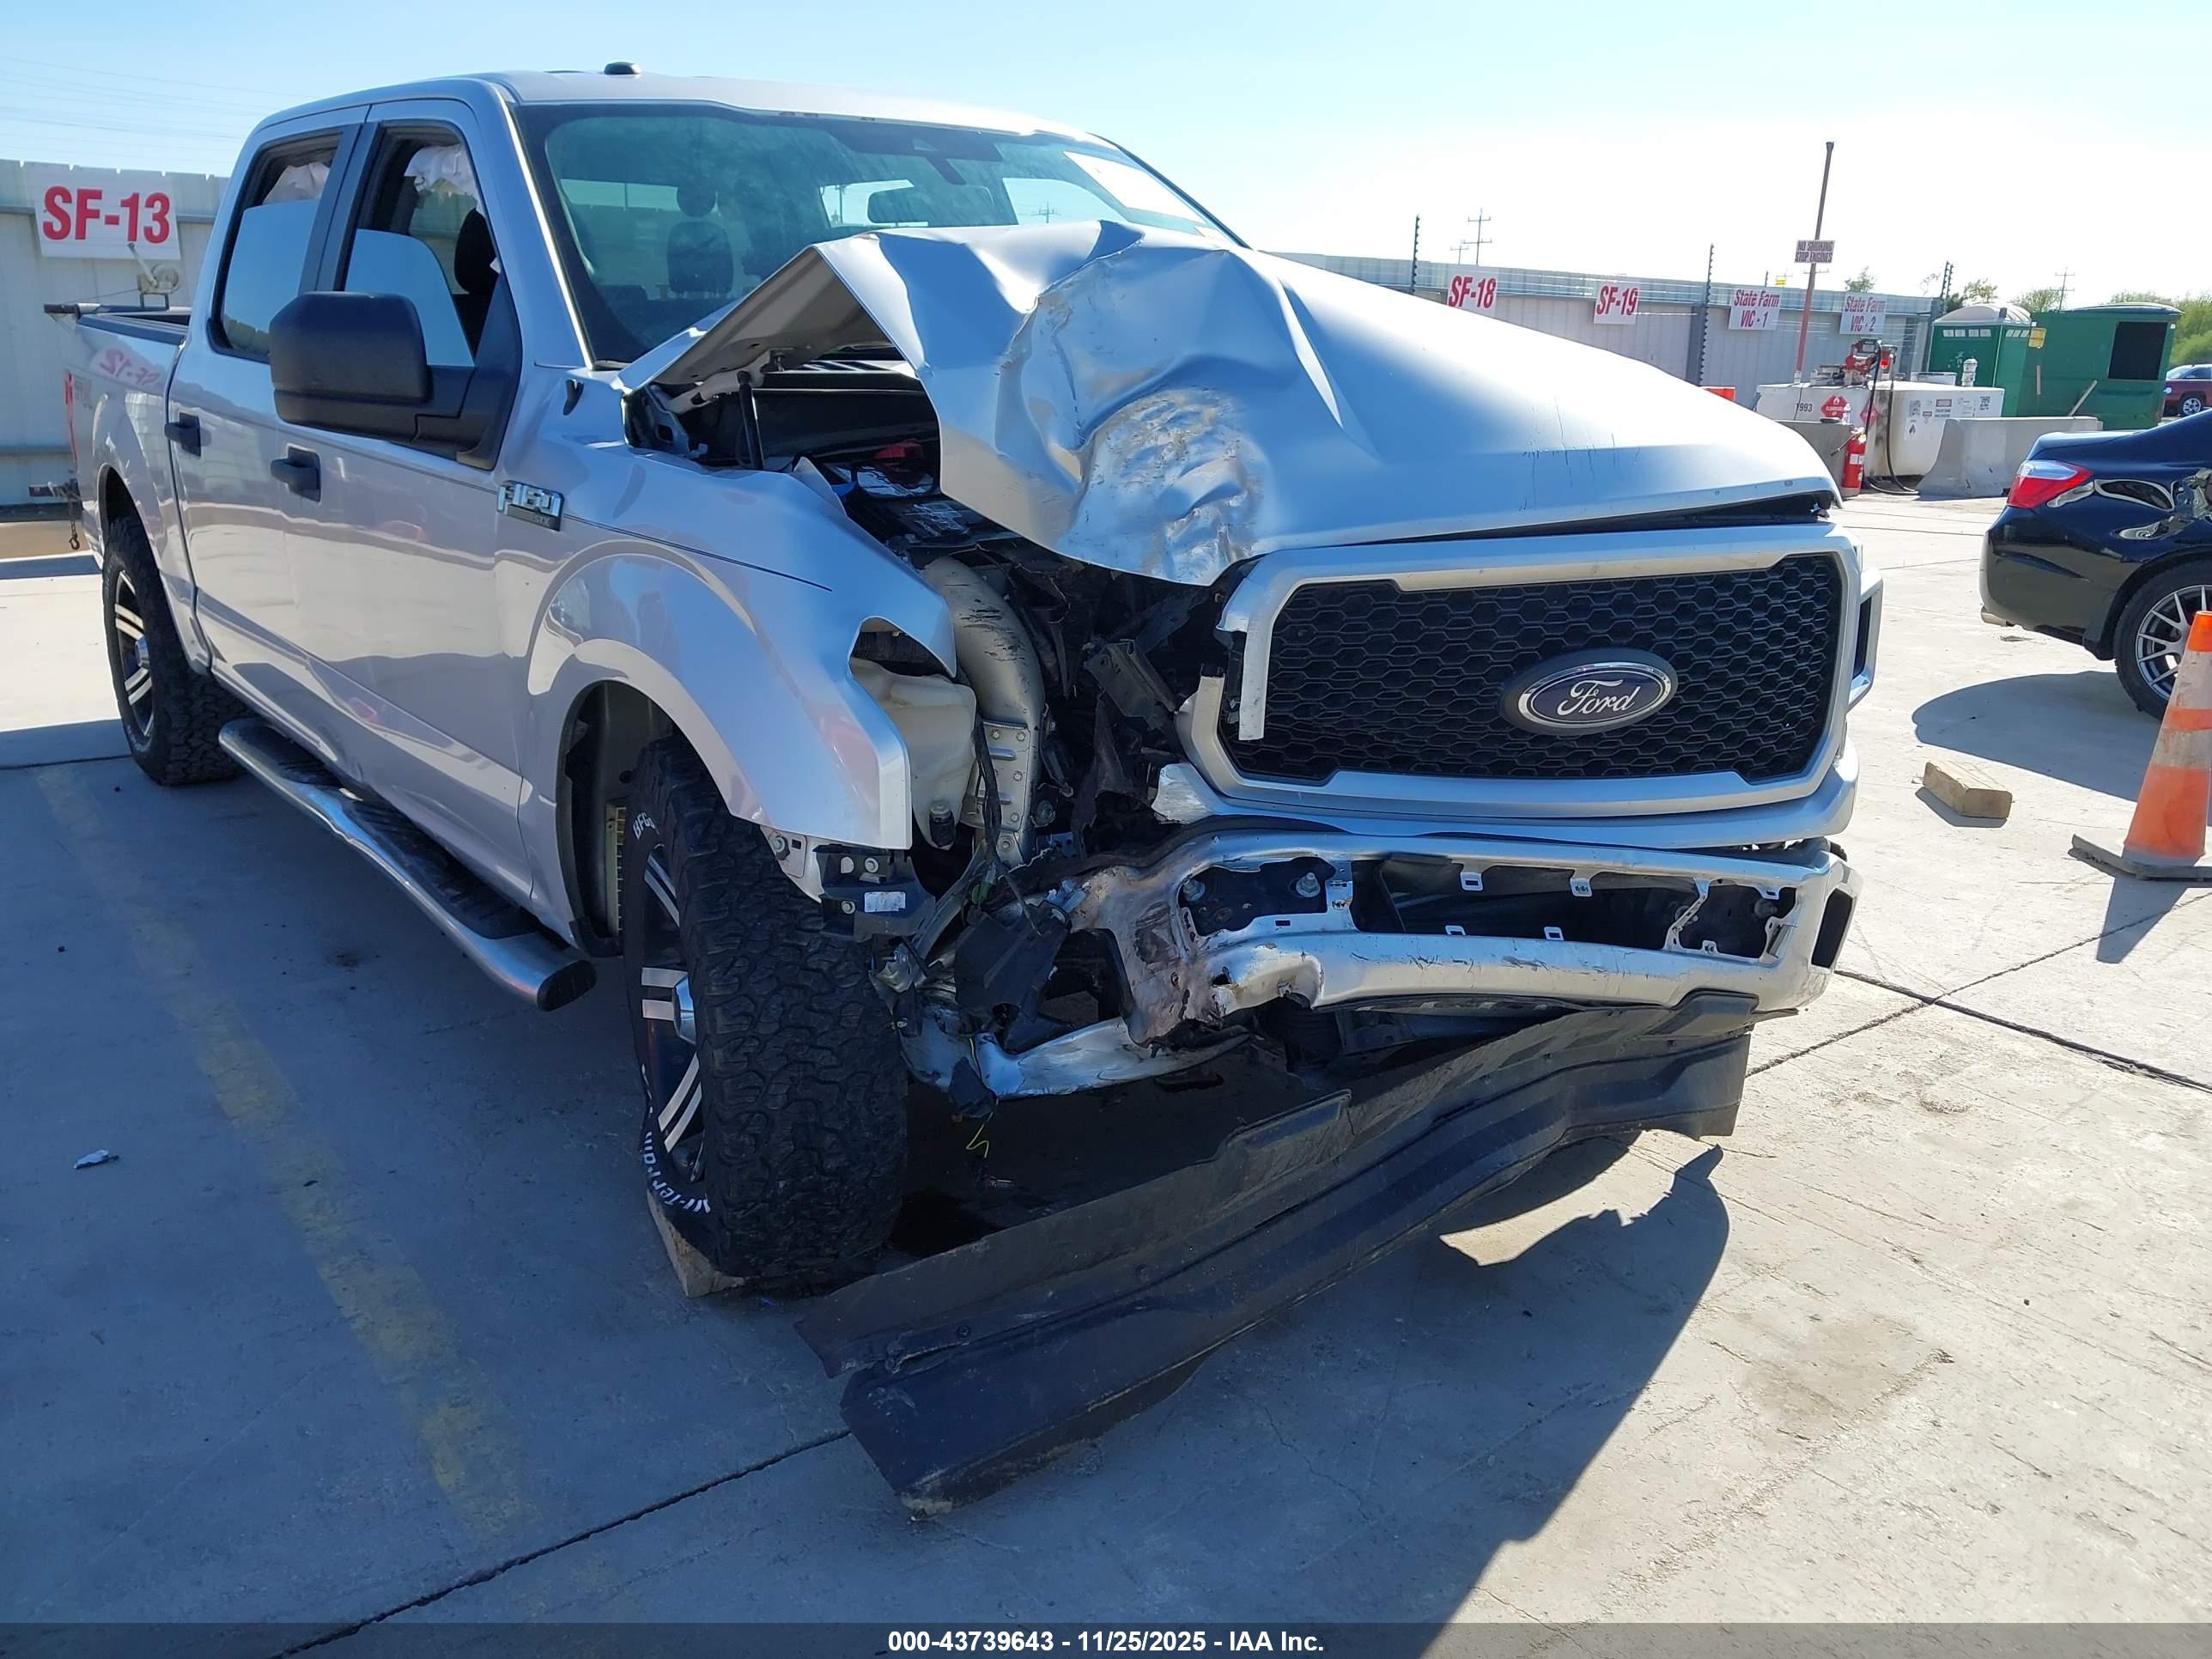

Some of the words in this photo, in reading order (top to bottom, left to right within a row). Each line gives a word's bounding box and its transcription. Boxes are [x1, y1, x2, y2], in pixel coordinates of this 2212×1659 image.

[42, 185, 171, 245] SF-13
[1796, 252, 1808, 262] STOP
[1449, 275, 1496, 308] SF-18
[1596, 285, 1638, 315] SF-19
[1734, 289, 1758, 307] State
[1758, 291, 1780, 308] Farm
[1844, 295, 1865, 313] State
[1866, 297, 1886, 313] Farm
[1740, 310, 1756, 327] VIC
[1762, 312, 1769, 328] 1
[1850, 315, 1864, 331] VIC
[1869, 316, 1876, 332] 2
[1557, 679, 1641, 716] Ford
